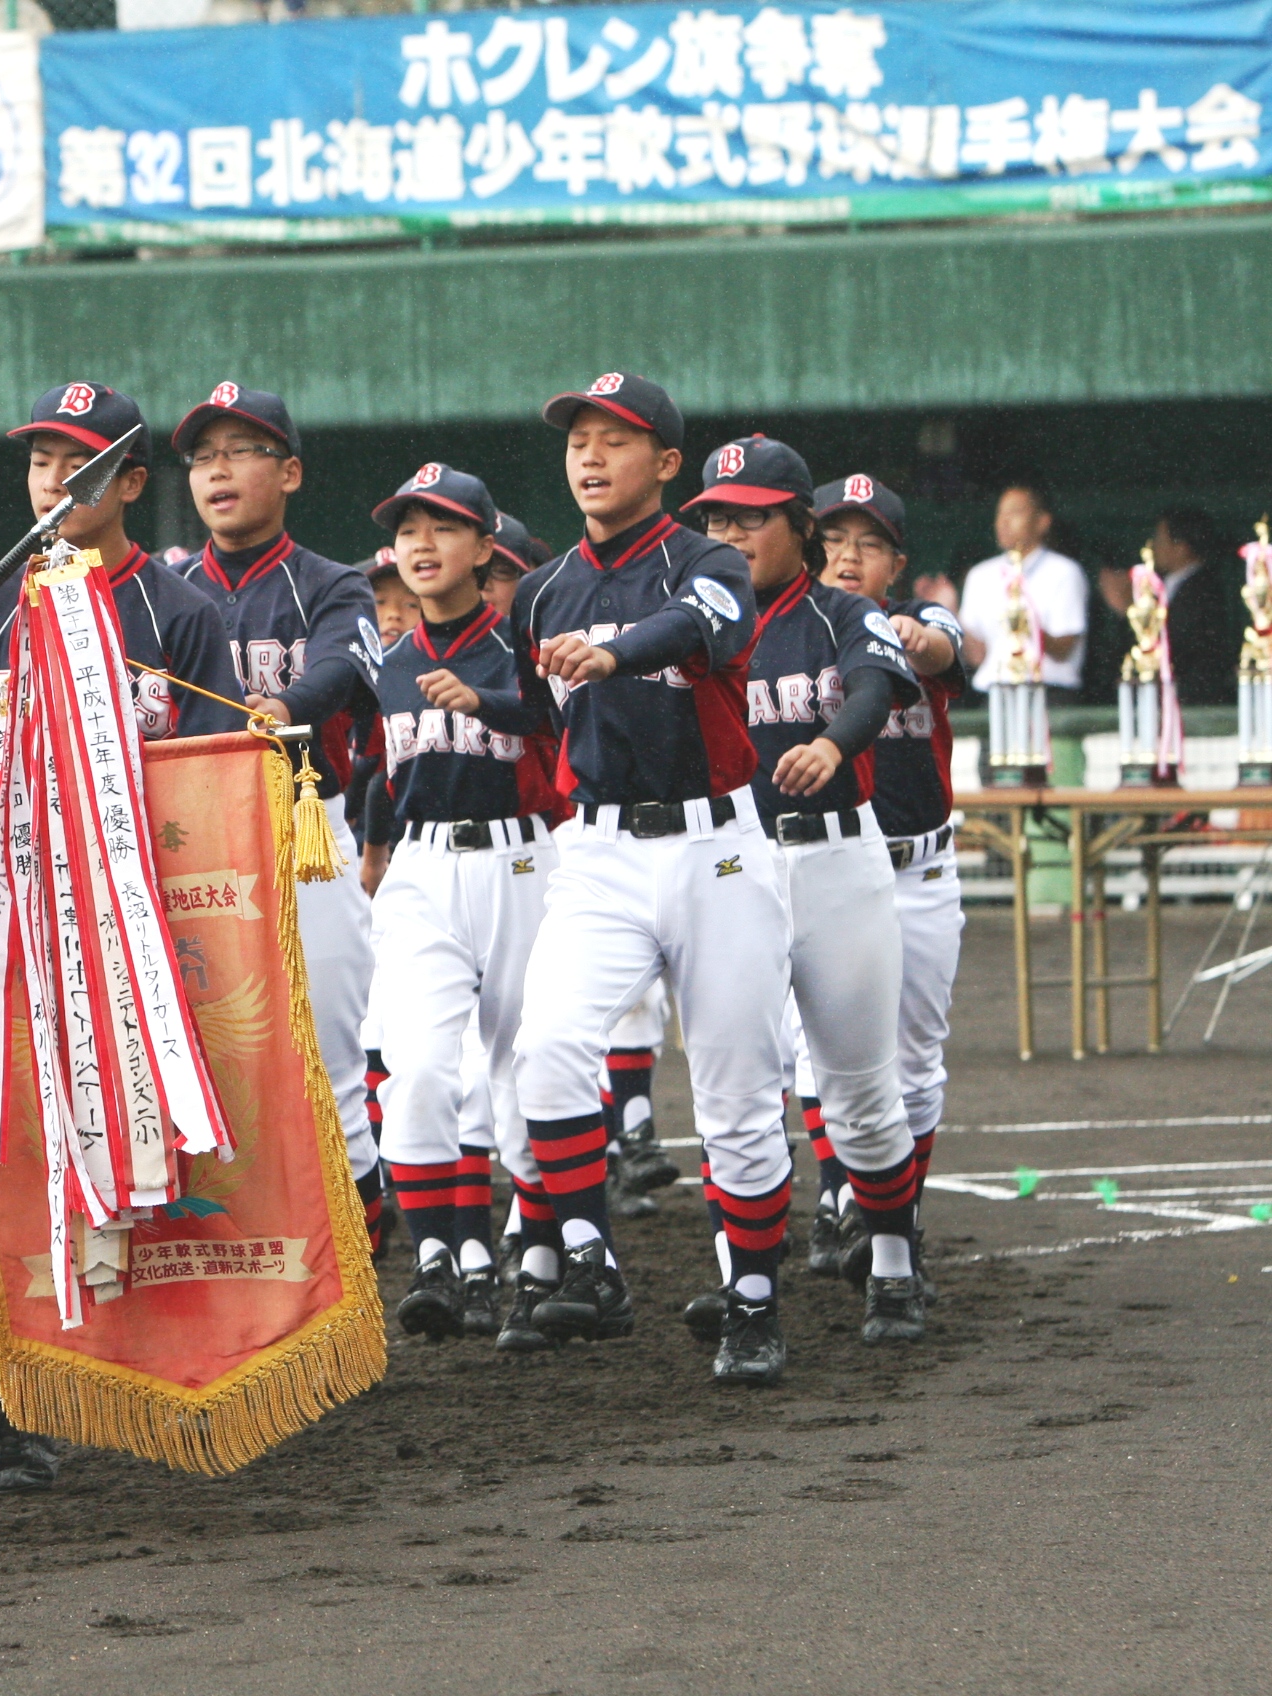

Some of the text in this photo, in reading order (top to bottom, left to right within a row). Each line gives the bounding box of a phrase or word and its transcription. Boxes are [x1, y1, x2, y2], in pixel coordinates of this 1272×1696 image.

[57, 382, 96, 416] B
[209, 380, 239, 408] B
[717, 444, 745, 478] B
[411, 462, 442, 492] B
[844, 473, 874, 503] B
